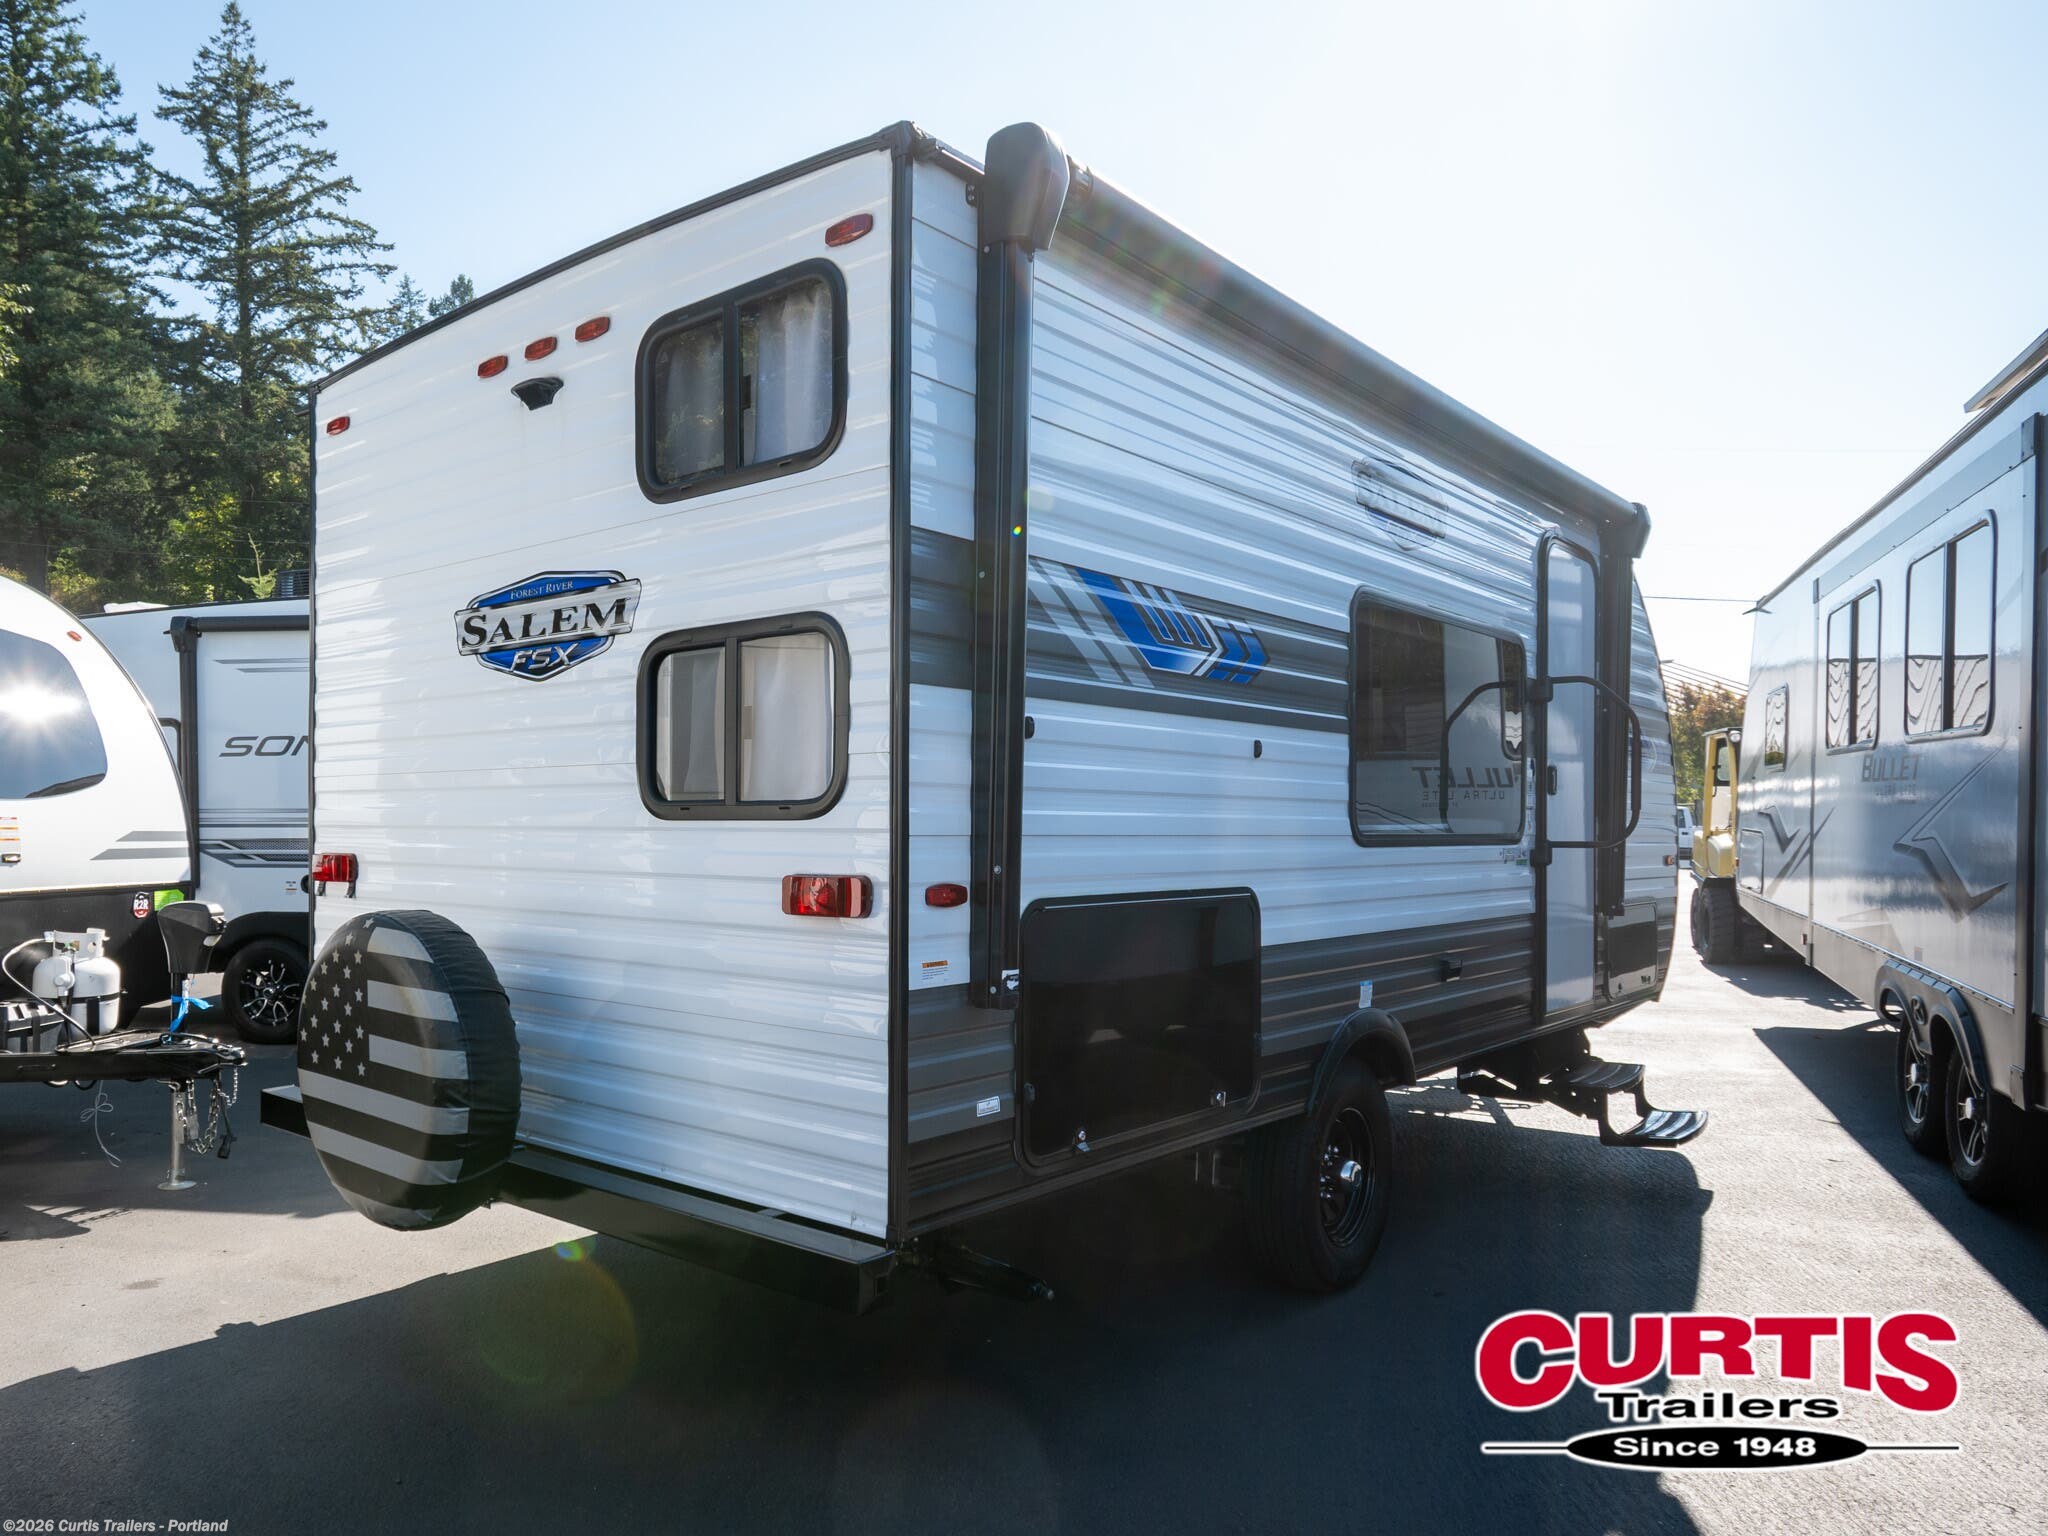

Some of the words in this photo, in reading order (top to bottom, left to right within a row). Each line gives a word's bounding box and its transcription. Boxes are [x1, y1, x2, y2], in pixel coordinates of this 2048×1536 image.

[510, 586, 545, 600] FOREST
[545, 581, 574, 593] RIVER
[461, 597, 632, 648] SALEM
[510, 643, 579, 672] FSX
[1861, 753, 1920, 782] BULLET
